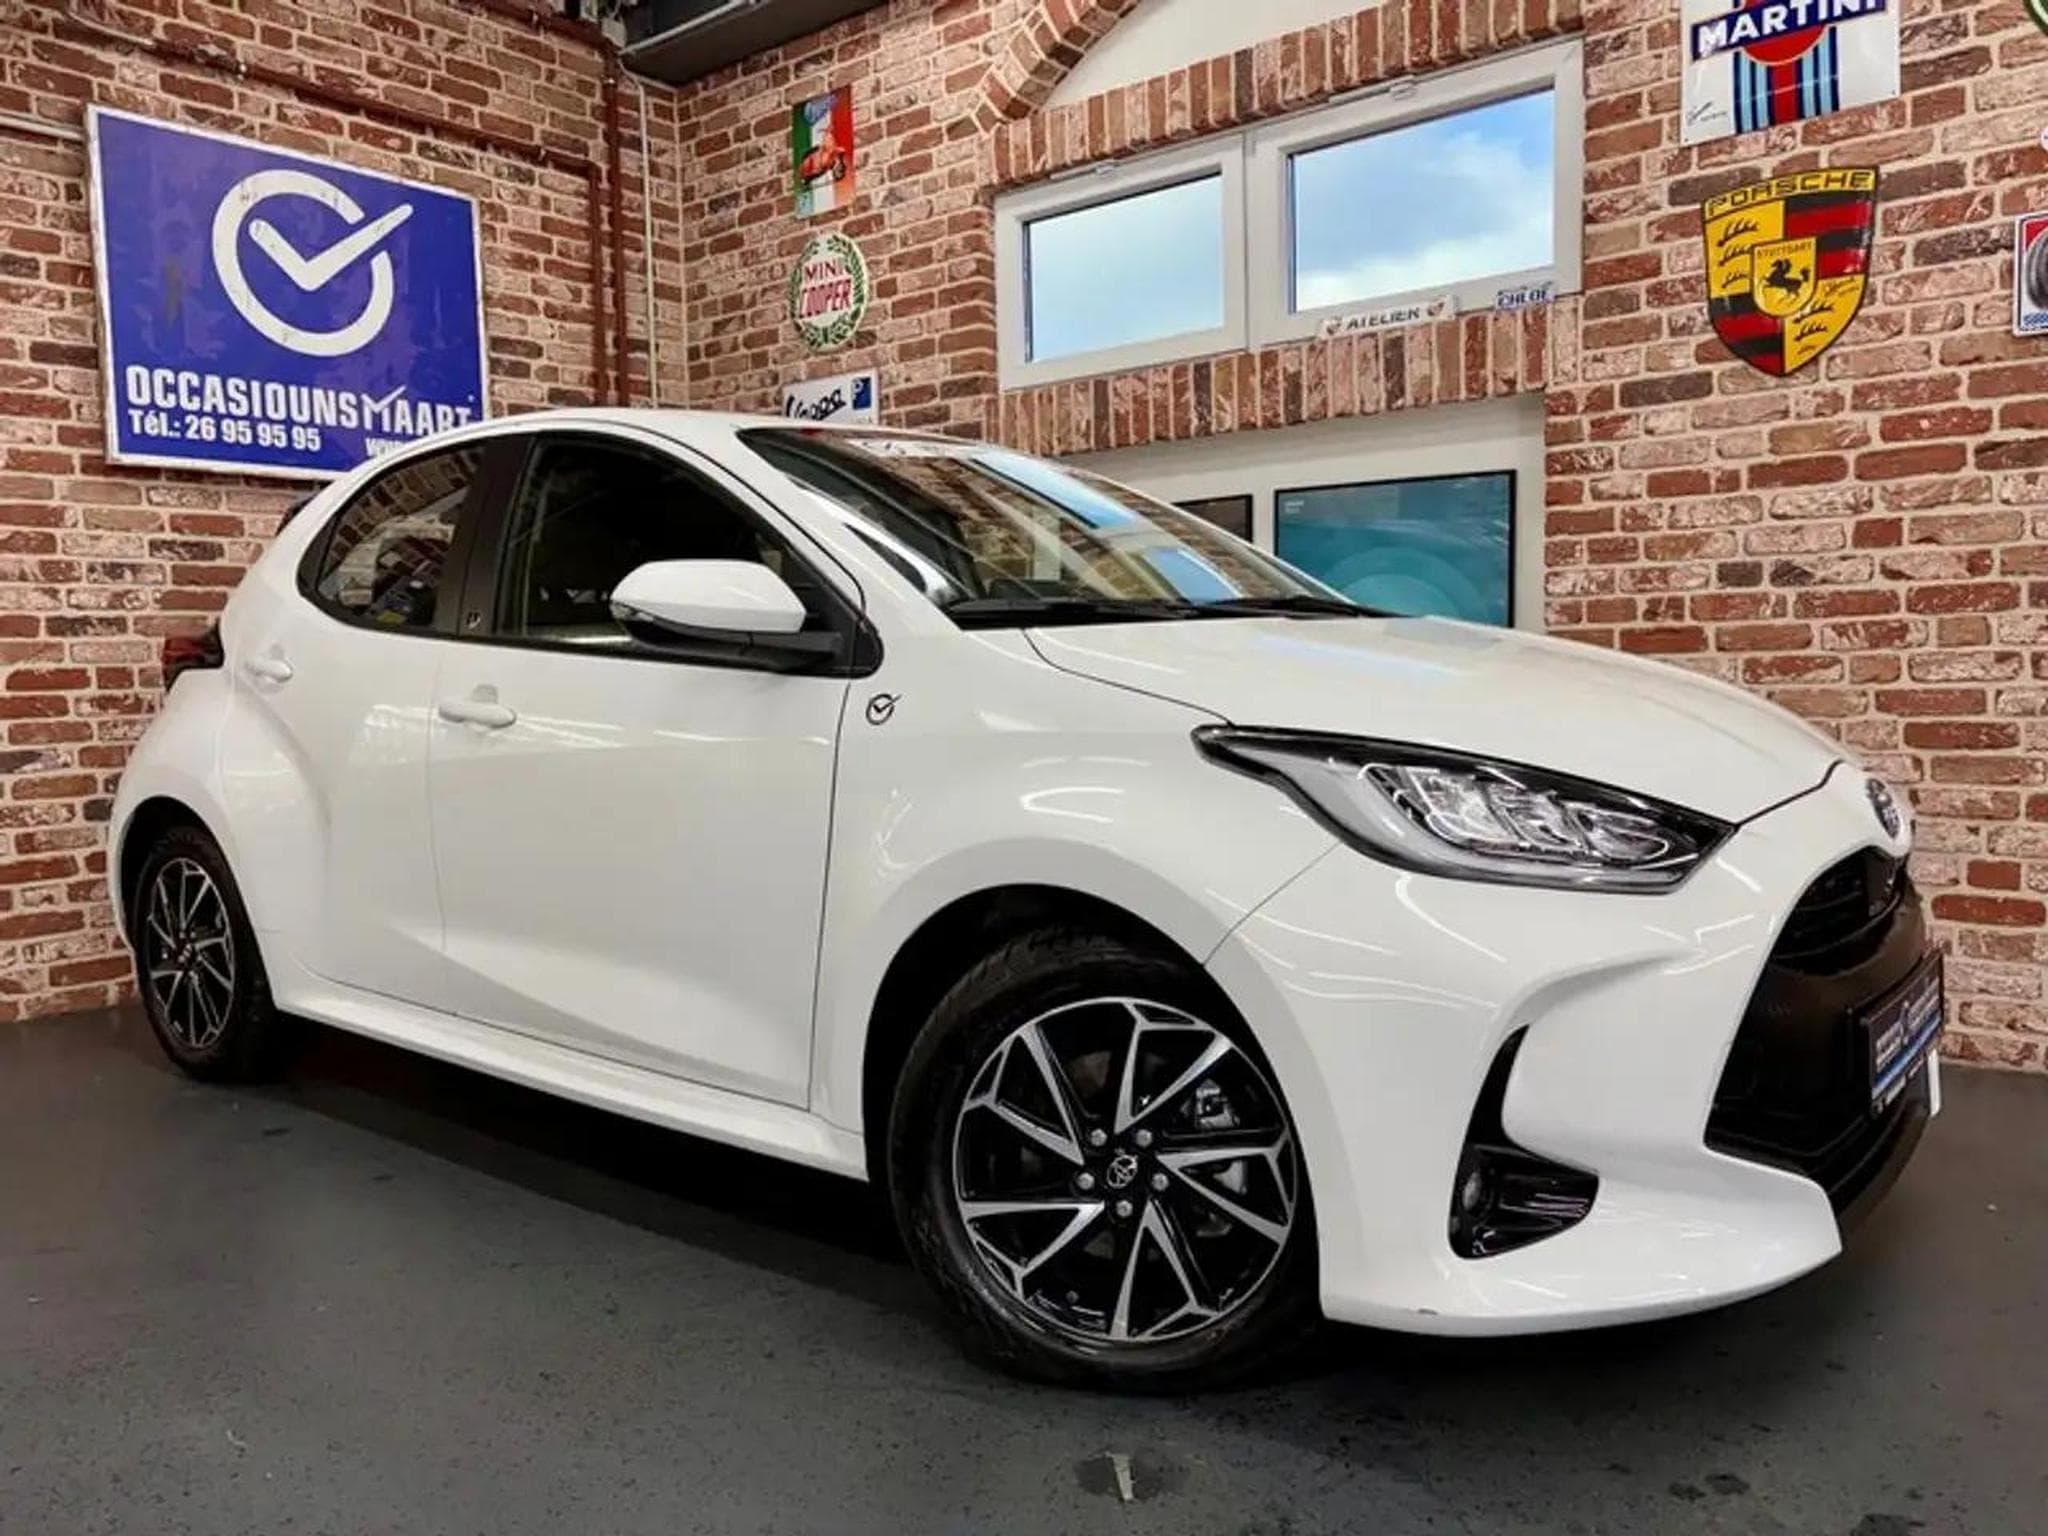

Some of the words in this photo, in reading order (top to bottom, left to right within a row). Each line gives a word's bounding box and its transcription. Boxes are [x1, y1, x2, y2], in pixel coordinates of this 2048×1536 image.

[1708, 170, 1871, 216] PORSCHE
[804, 258, 845, 280] MINI
[800, 279, 852, 318] COOPER
[1346, 306, 1421, 331] ATELIER
[185, 414, 216, 441] 26
[221, 420, 253, 445] 95
[257, 423, 289, 449] 95
[293, 425, 321, 452] 95
